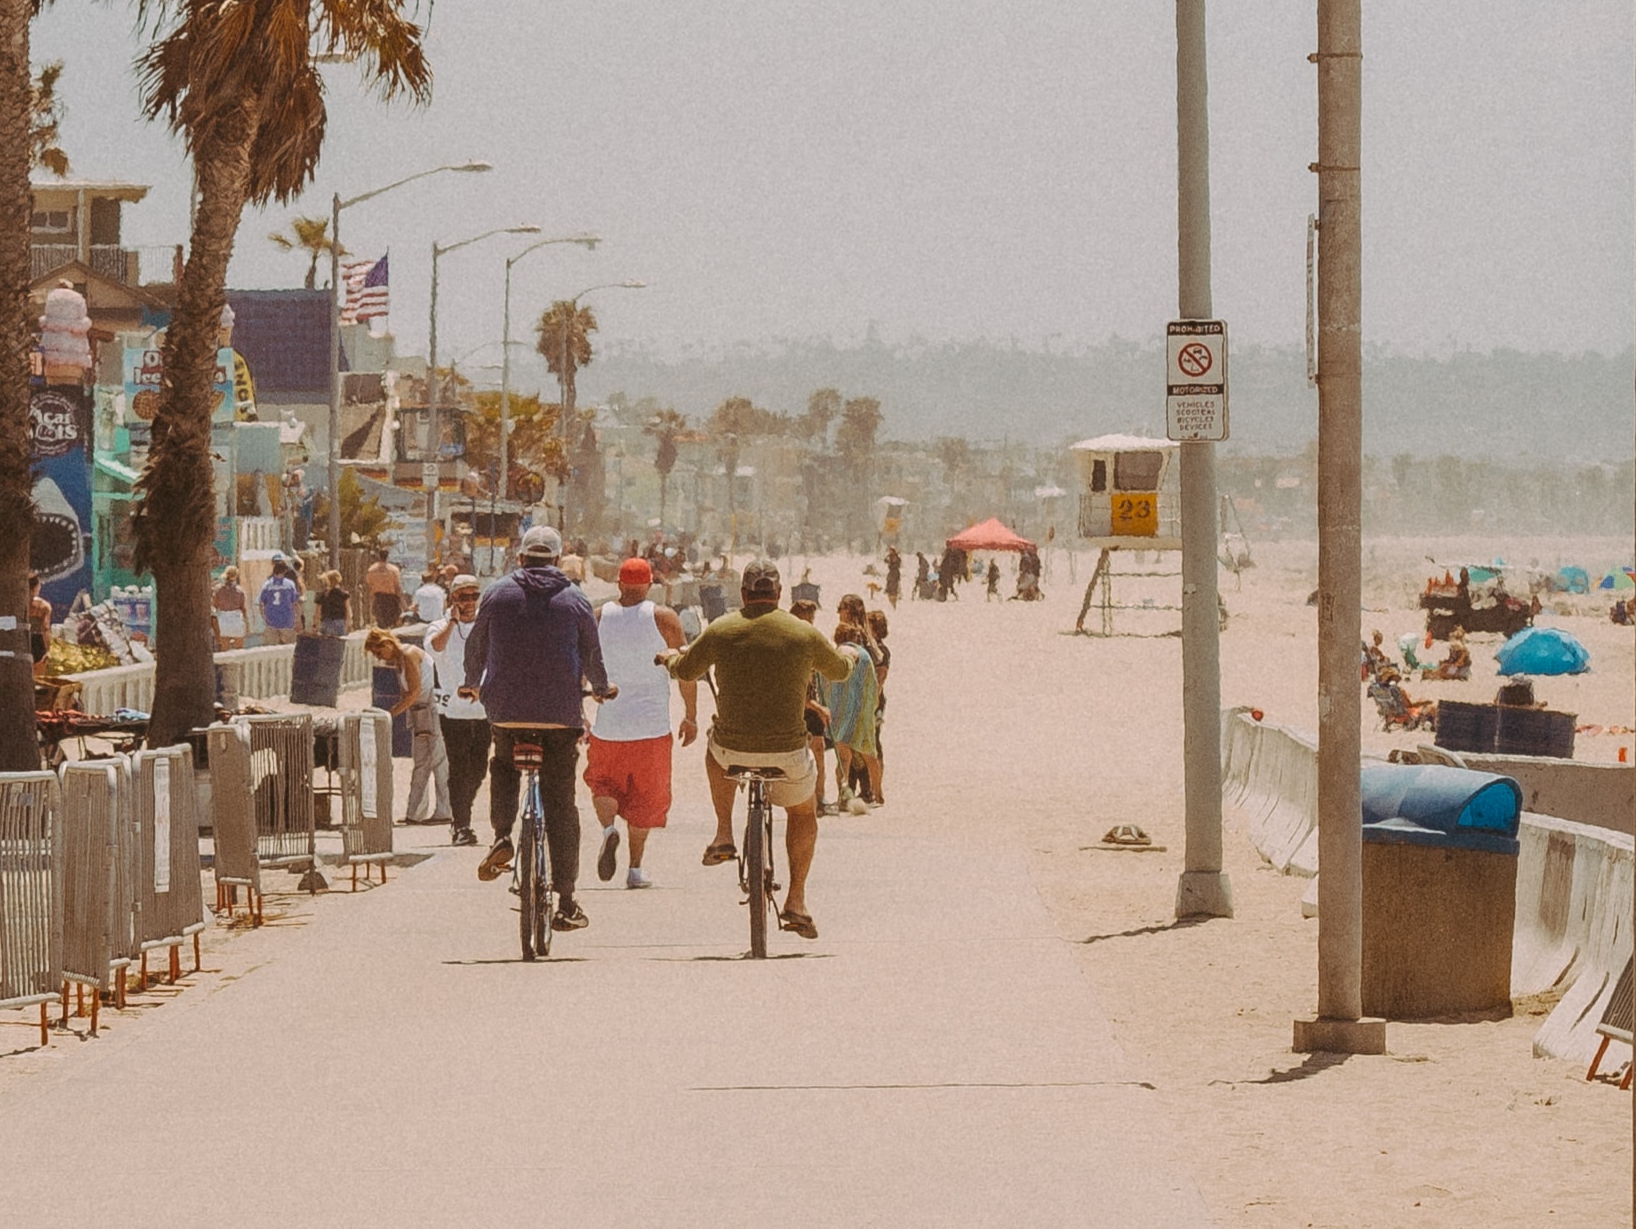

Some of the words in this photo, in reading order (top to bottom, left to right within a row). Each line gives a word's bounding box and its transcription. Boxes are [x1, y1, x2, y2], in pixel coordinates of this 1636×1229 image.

[1169, 324, 1221, 333] PROHIBITED
[1172, 386, 1219, 394] MOTORIZED
[1177, 401, 1215, 409] VEHICLES
[1180, 423, 1212, 431] DEVICES
[1119, 499, 1151, 519] 23
[272, 591, 281, 605] 1
